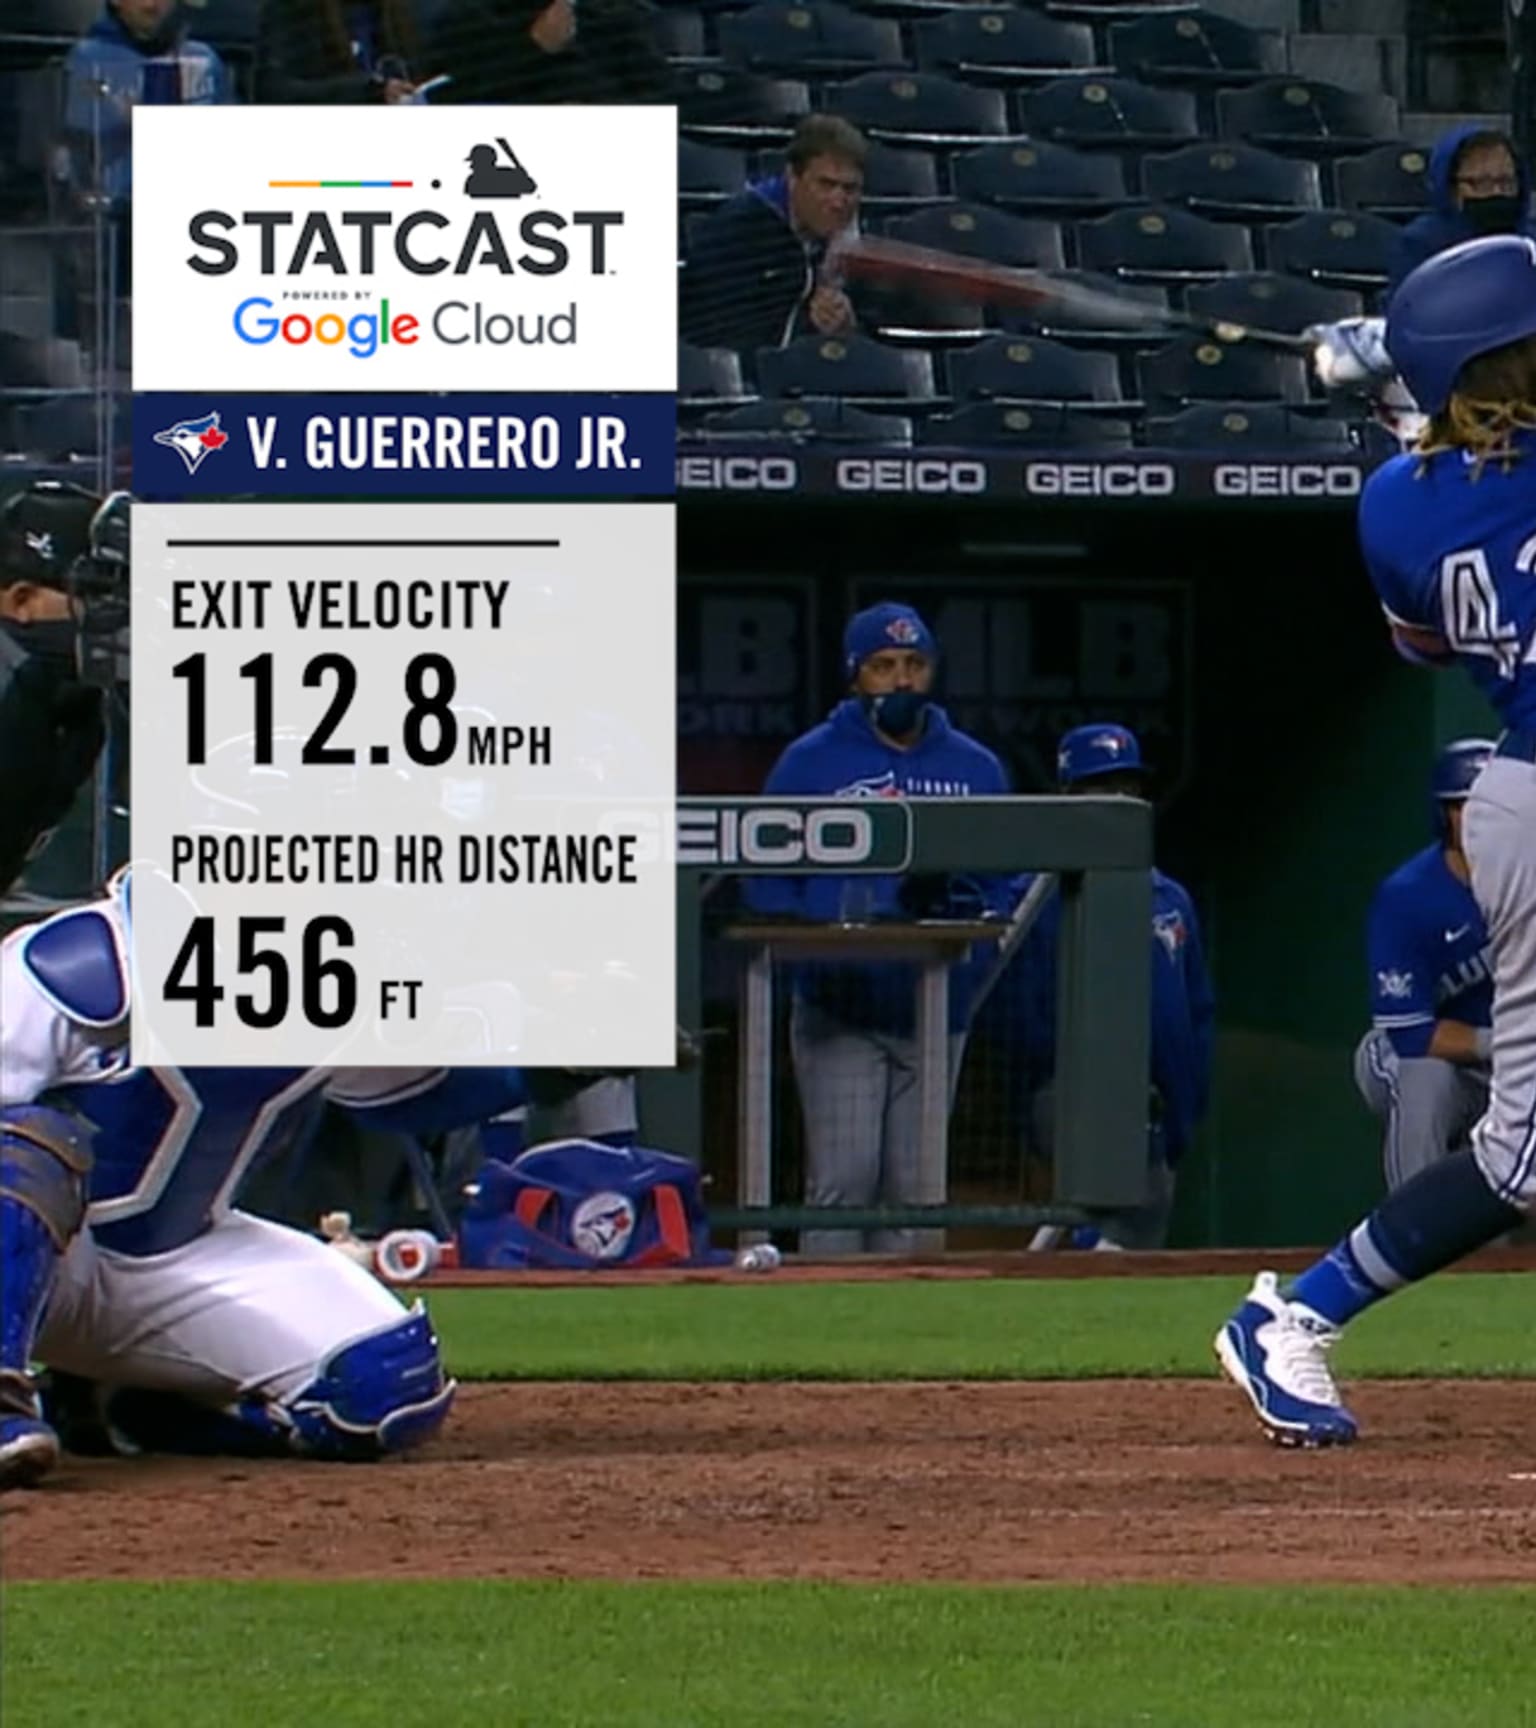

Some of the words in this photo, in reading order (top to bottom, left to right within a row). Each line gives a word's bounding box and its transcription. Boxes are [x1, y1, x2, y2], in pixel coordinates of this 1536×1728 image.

[676, 457, 797, 489] EICO
[838, 460, 986, 493] GEICO
[1026, 463, 1175, 496] GEICO
[1214, 464, 1361, 497] GEICO
